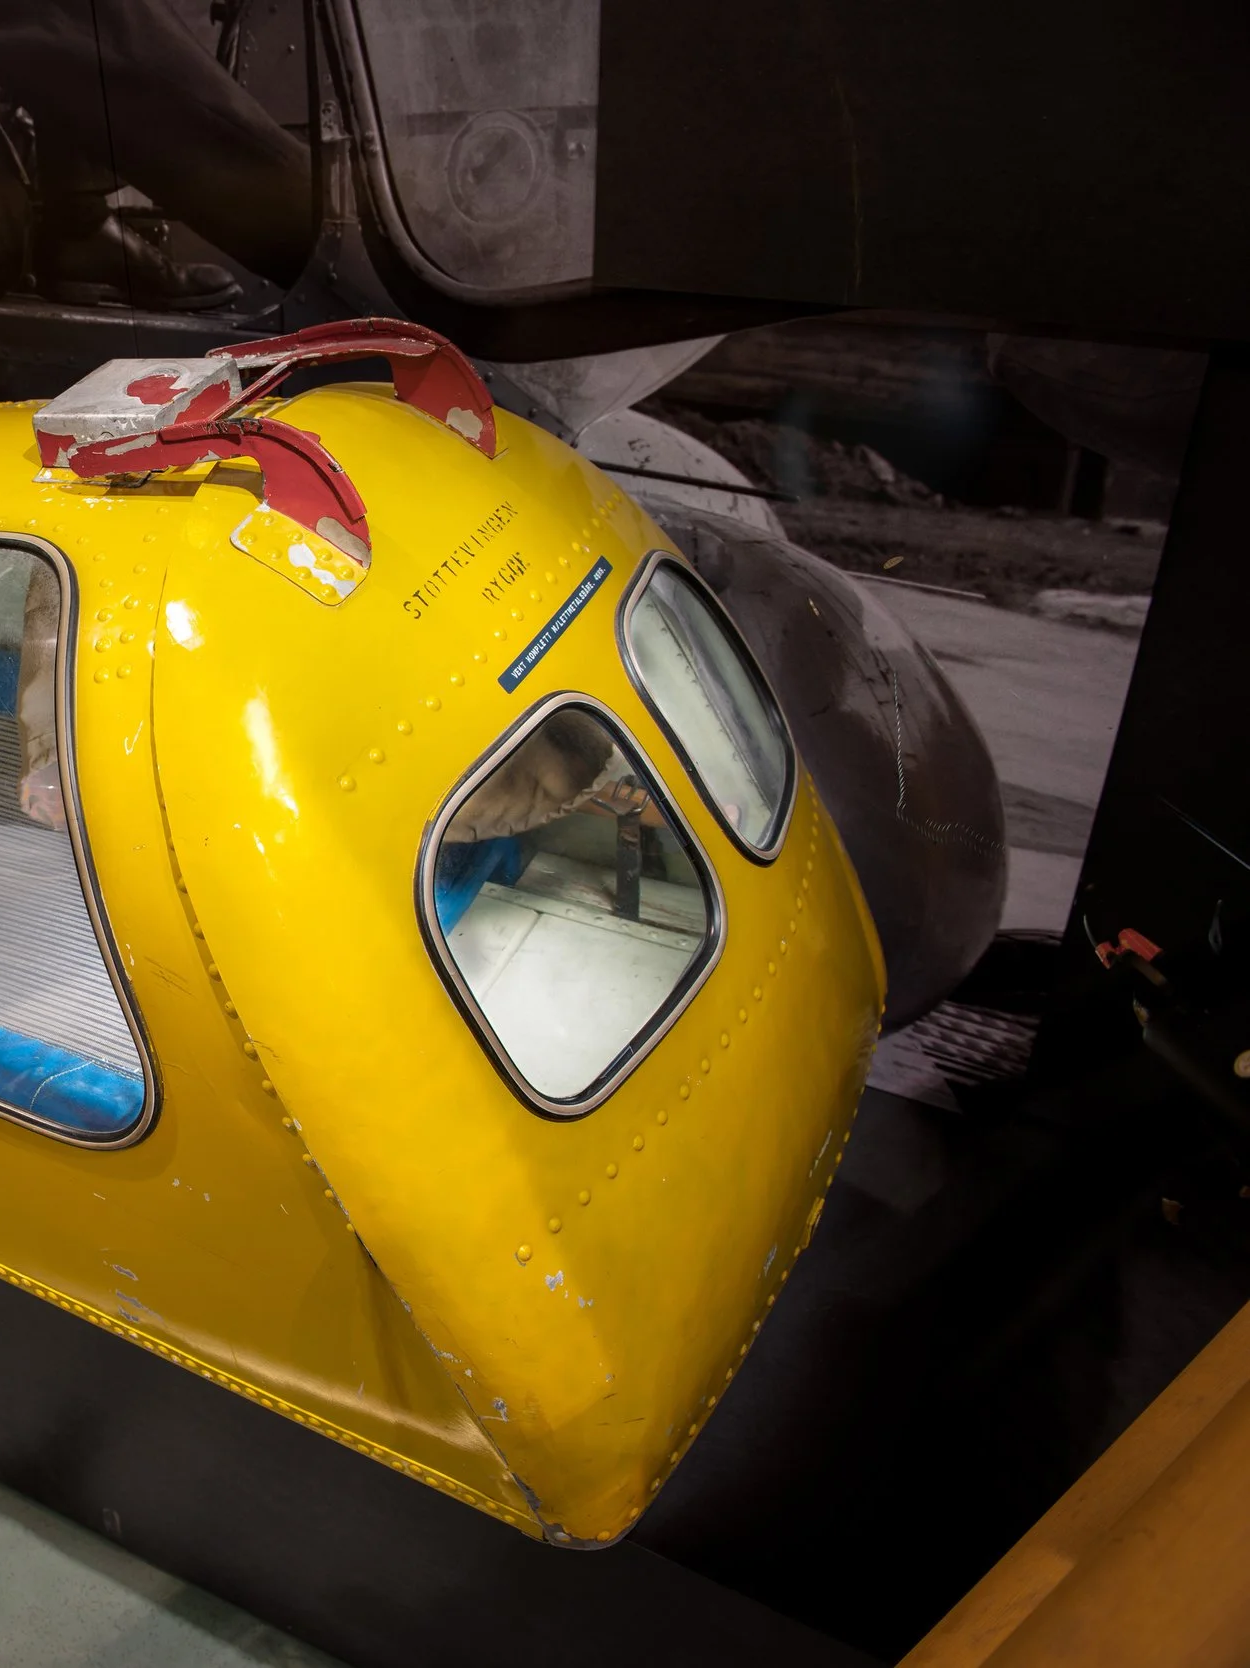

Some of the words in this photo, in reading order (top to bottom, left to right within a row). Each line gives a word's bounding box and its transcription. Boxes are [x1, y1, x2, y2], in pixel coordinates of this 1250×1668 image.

[481, 551, 531, 605] RYGGE
[510, 661, 528, 680] VEKT
[524, 631, 553, 664] KOMPLETT
